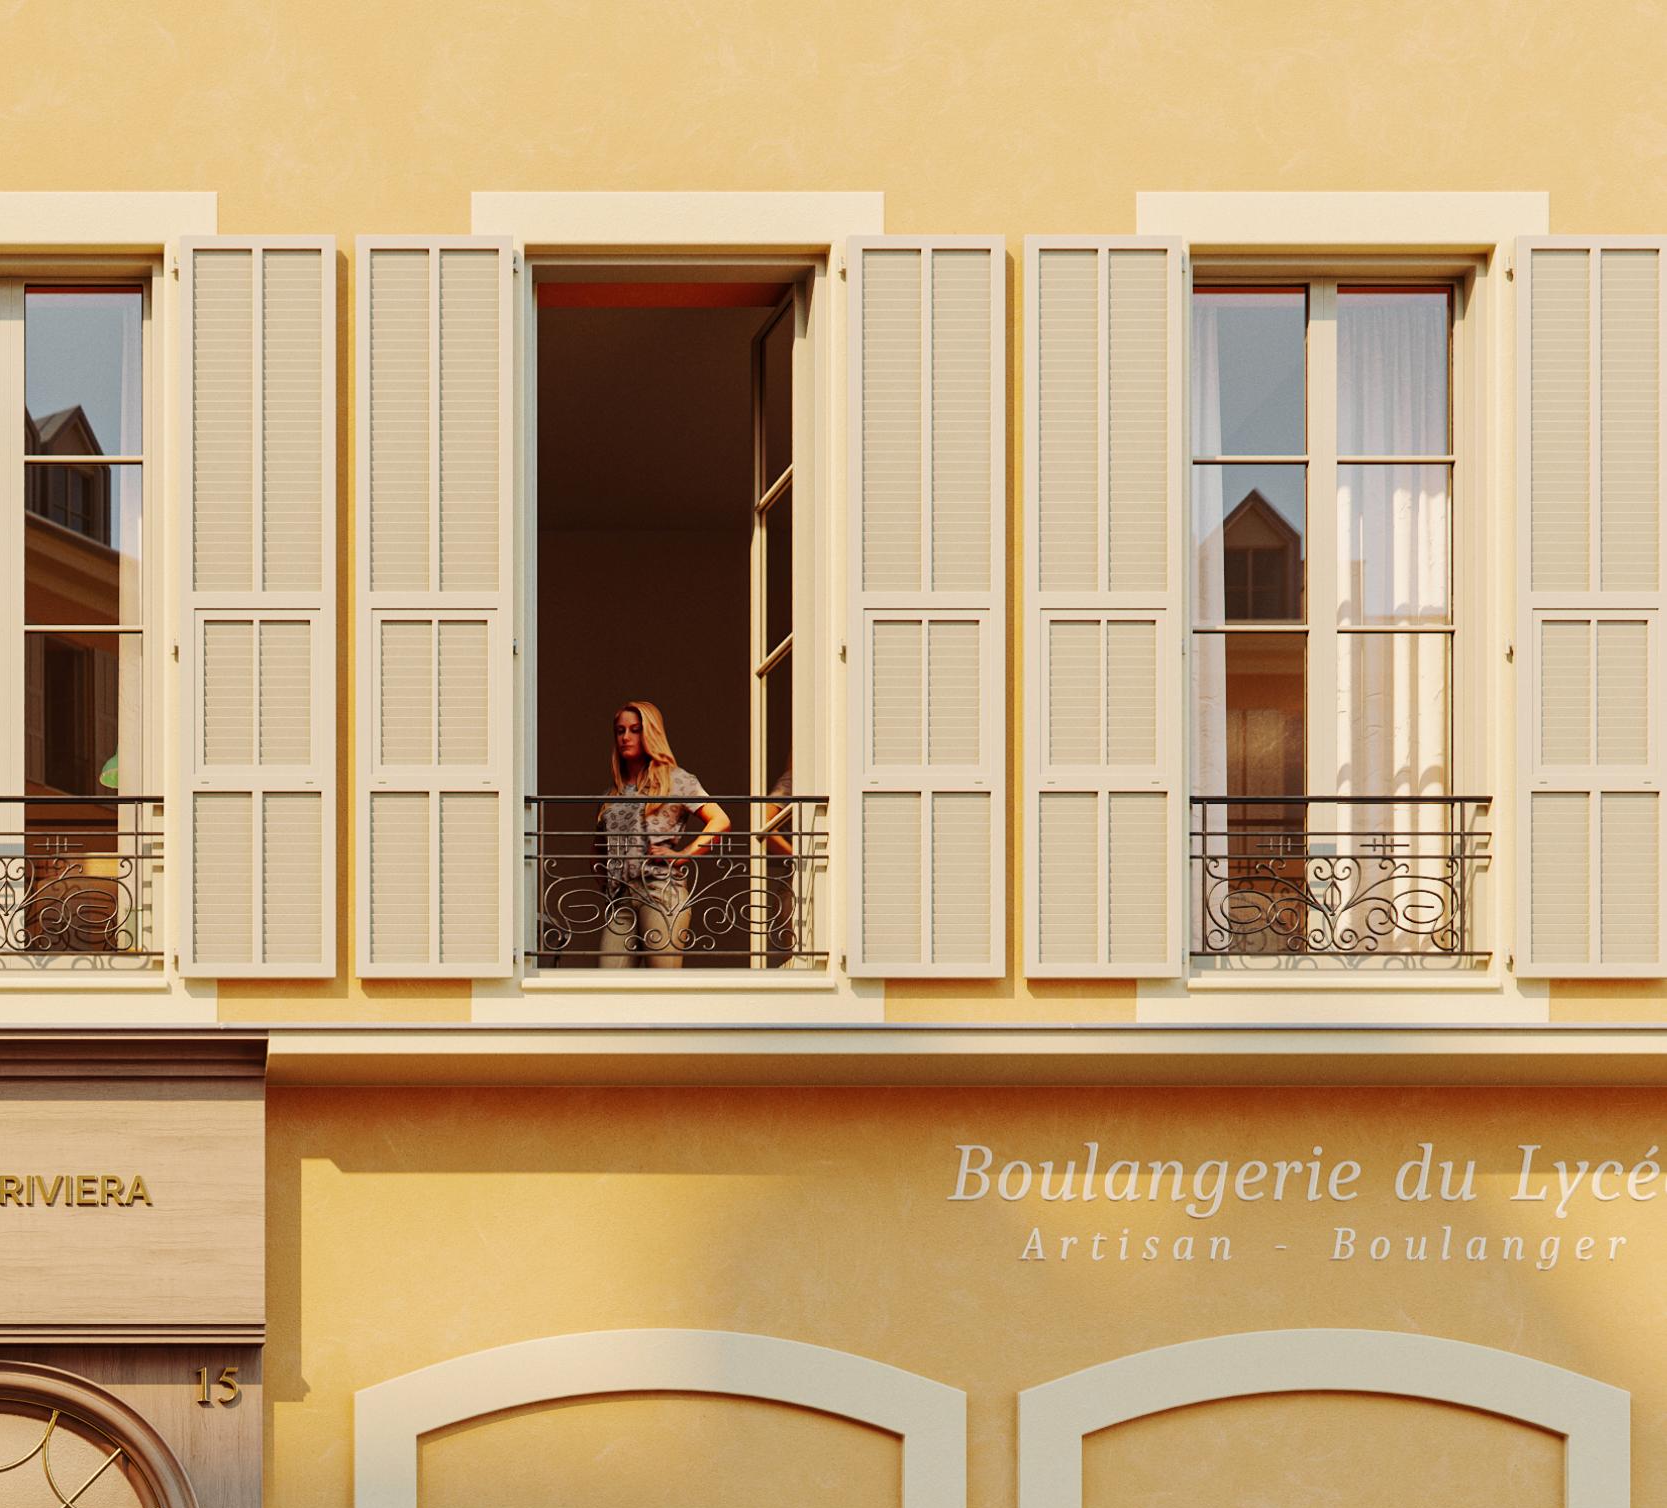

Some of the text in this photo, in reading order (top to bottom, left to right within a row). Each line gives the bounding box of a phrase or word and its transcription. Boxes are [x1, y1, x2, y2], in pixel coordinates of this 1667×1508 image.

[946, 1142, 1667, 1219] Boulangerie du Lycé
[1018, 1226, 1234, 1262] Artisan
[1330, 1225, 1629, 1271] Boulanger
[196, 1366, 239, 1404] 15
